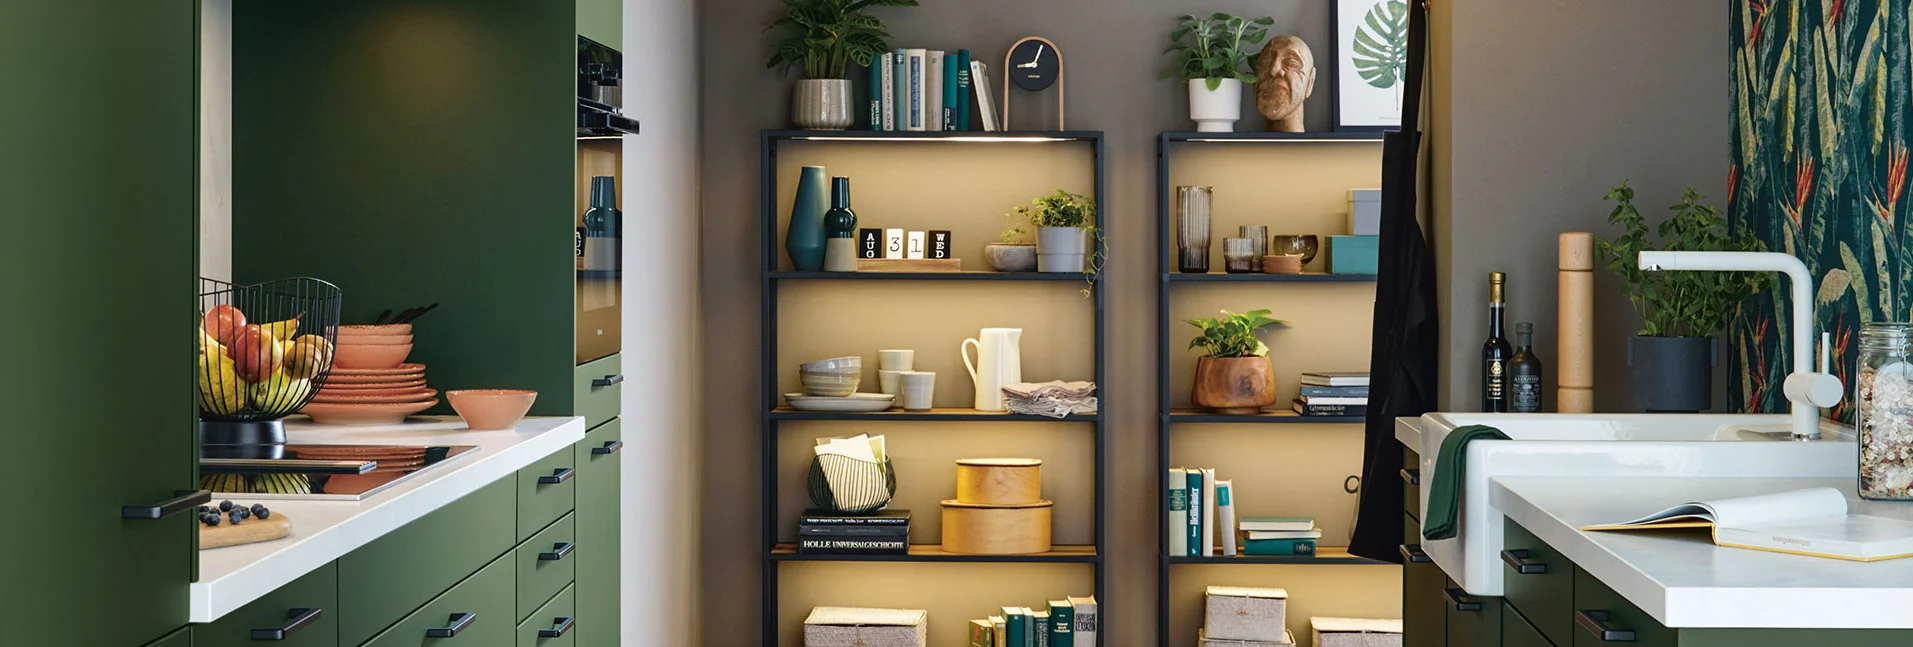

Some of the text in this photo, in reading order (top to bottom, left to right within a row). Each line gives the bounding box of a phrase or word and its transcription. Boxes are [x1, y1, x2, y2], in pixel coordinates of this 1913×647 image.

[866, 232, 875, 258] AUG
[936, 233, 945, 258] WED
[803, 540, 831, 548] HOLLE
